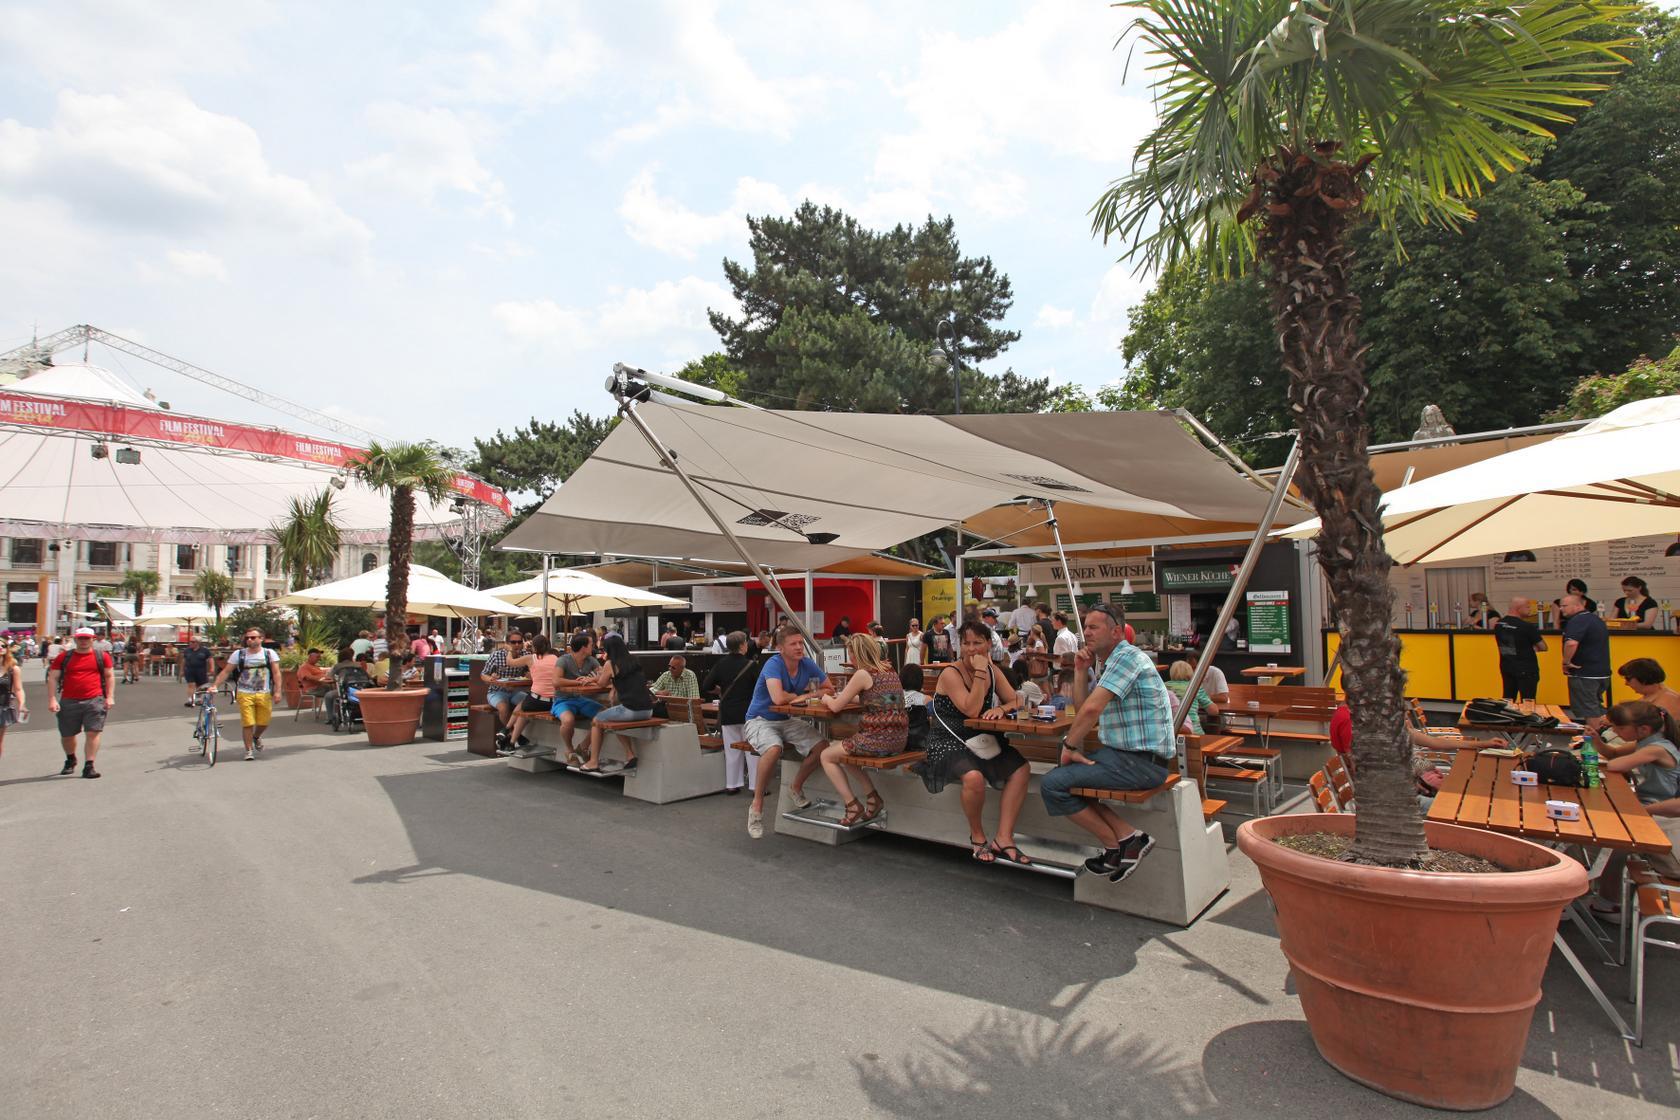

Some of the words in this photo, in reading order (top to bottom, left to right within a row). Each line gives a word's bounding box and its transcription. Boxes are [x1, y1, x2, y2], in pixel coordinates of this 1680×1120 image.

[13, 400, 67, 416] FESTIVAL
[159, 419, 182, 433] FILM
[183, 422, 225, 437] FESTIVAL
[295, 441, 312, 454] FILM
[312, 444, 342, 458] FESTIVAL
[1165, 572, 1199, 582] WIENER
[1200, 570, 1231, 581] KÜCHE
